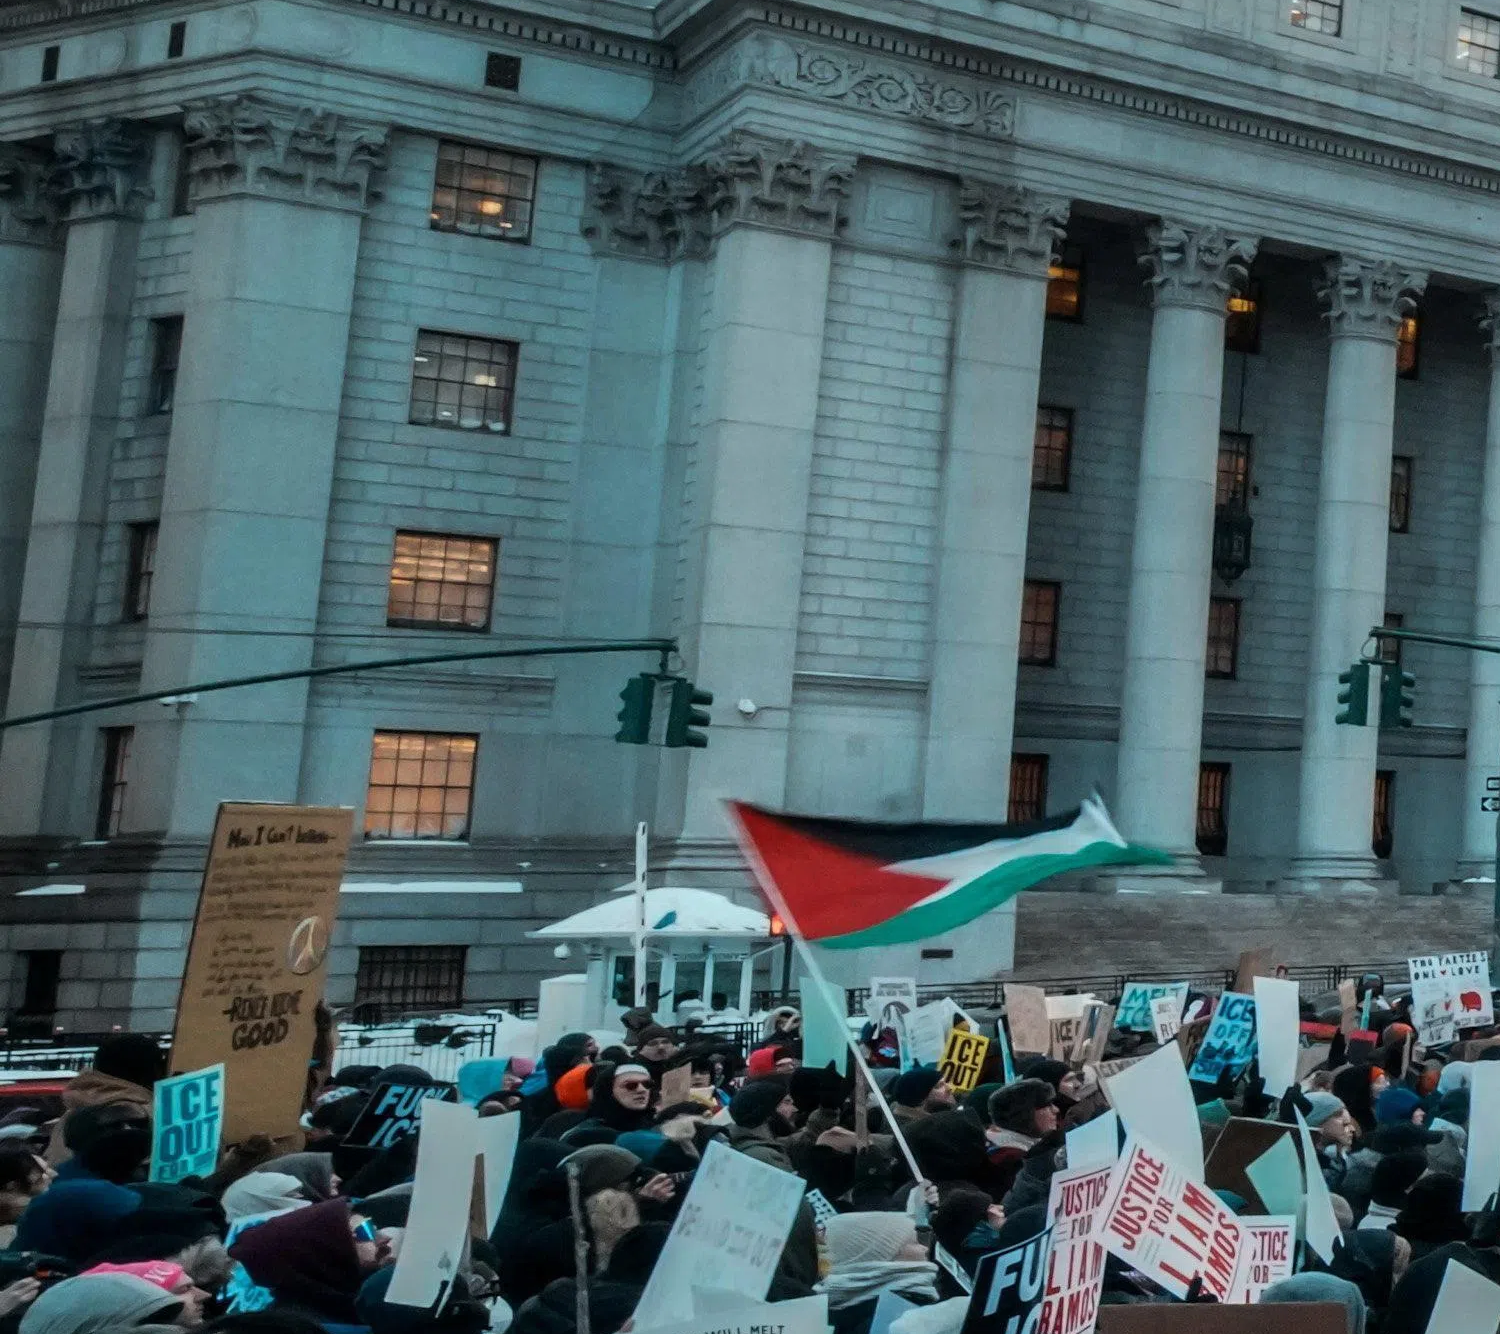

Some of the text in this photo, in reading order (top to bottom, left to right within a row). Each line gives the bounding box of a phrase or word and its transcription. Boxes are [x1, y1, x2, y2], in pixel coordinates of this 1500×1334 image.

[1413, 966, 1481, 980] ONE LOVE
[1438, 955, 1487, 967] PARTIES
[1220, 996, 1255, 1022] ICE
[232, 1019, 290, 1051] GOOD
[1214, 1023, 1251, 1039] OFF
[945, 1034, 986, 1065] ICE
[941, 1059, 978, 1088] OUT
[161, 1070, 220, 1126] ICE
[375, 1083, 451, 1117] FU
[160, 1113, 219, 1164] OUT
[1055, 1170, 1112, 1218] JUSTICE
[1110, 1148, 1166, 1252] JUSTICE
[1070, 1215, 1093, 1239] FOR
[1149, 1196, 1175, 1237] FOR
[1158, 1181, 1218, 1288] LIAM
[1252, 1231, 1288, 1262] TICE
[983, 1233, 1049, 1317] FU
[1045, 1240, 1103, 1296] LIAM
